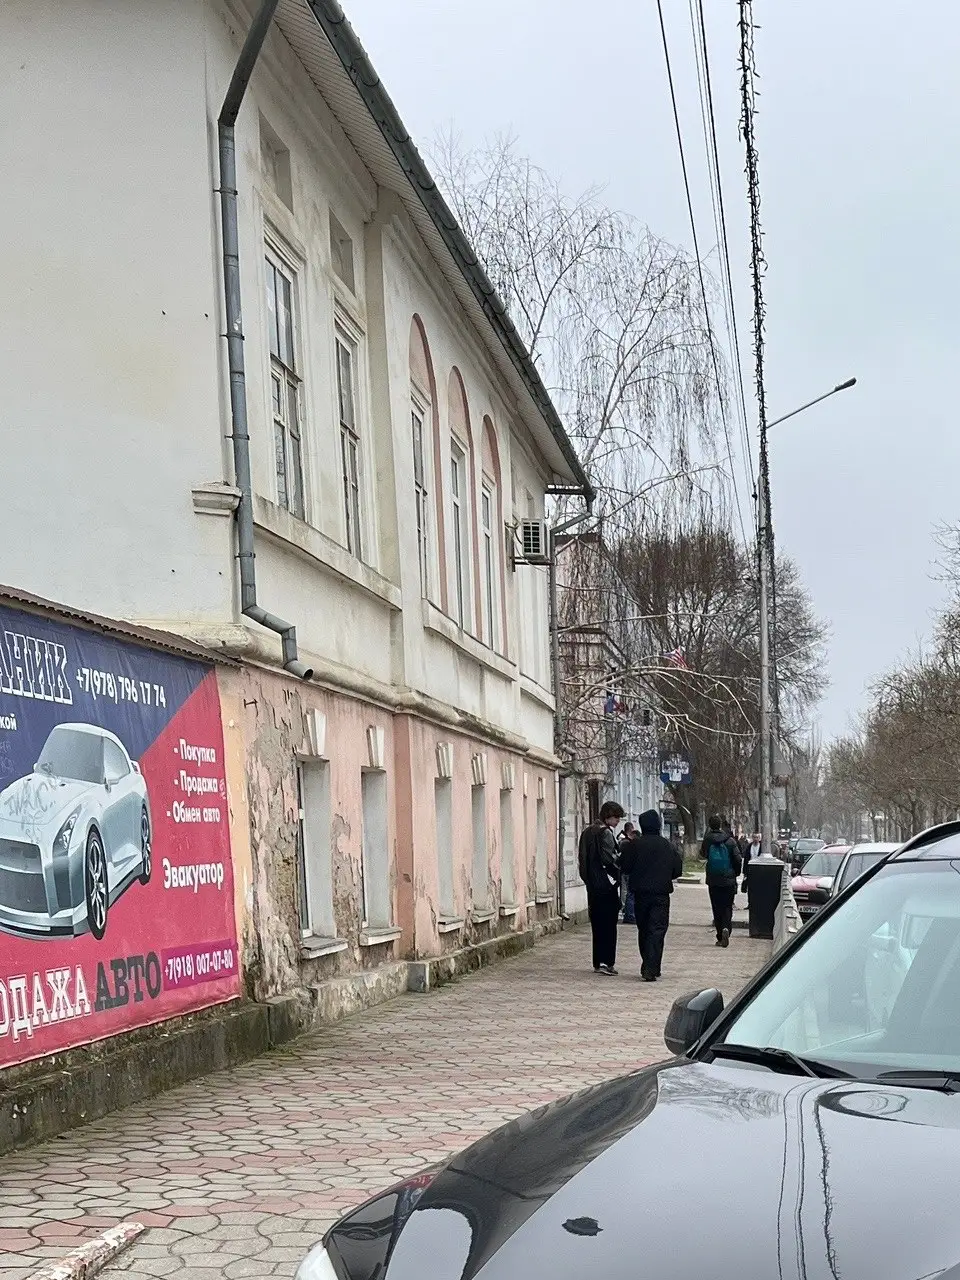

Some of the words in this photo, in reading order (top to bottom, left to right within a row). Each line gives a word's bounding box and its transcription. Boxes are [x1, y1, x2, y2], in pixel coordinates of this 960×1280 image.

[76, 667, 118, 705] +7(978)
[118, 676, 139, 703] 796
[140, 681, 151, 705] 17
[154, 684, 167, 708] 74
[179, 738, 216, 767] Покупка
[179, 770, 219, 797] Продажа
[172, 801, 201, 823] Обмен
[202, 808, 221, 823] авто
[162, 858, 224, 893] Эвакуатор
[94, 951, 162, 1012] АВТО
[165, 953, 195, 984] +7(918)
[196, 949, 233, 975] 007-07-80
